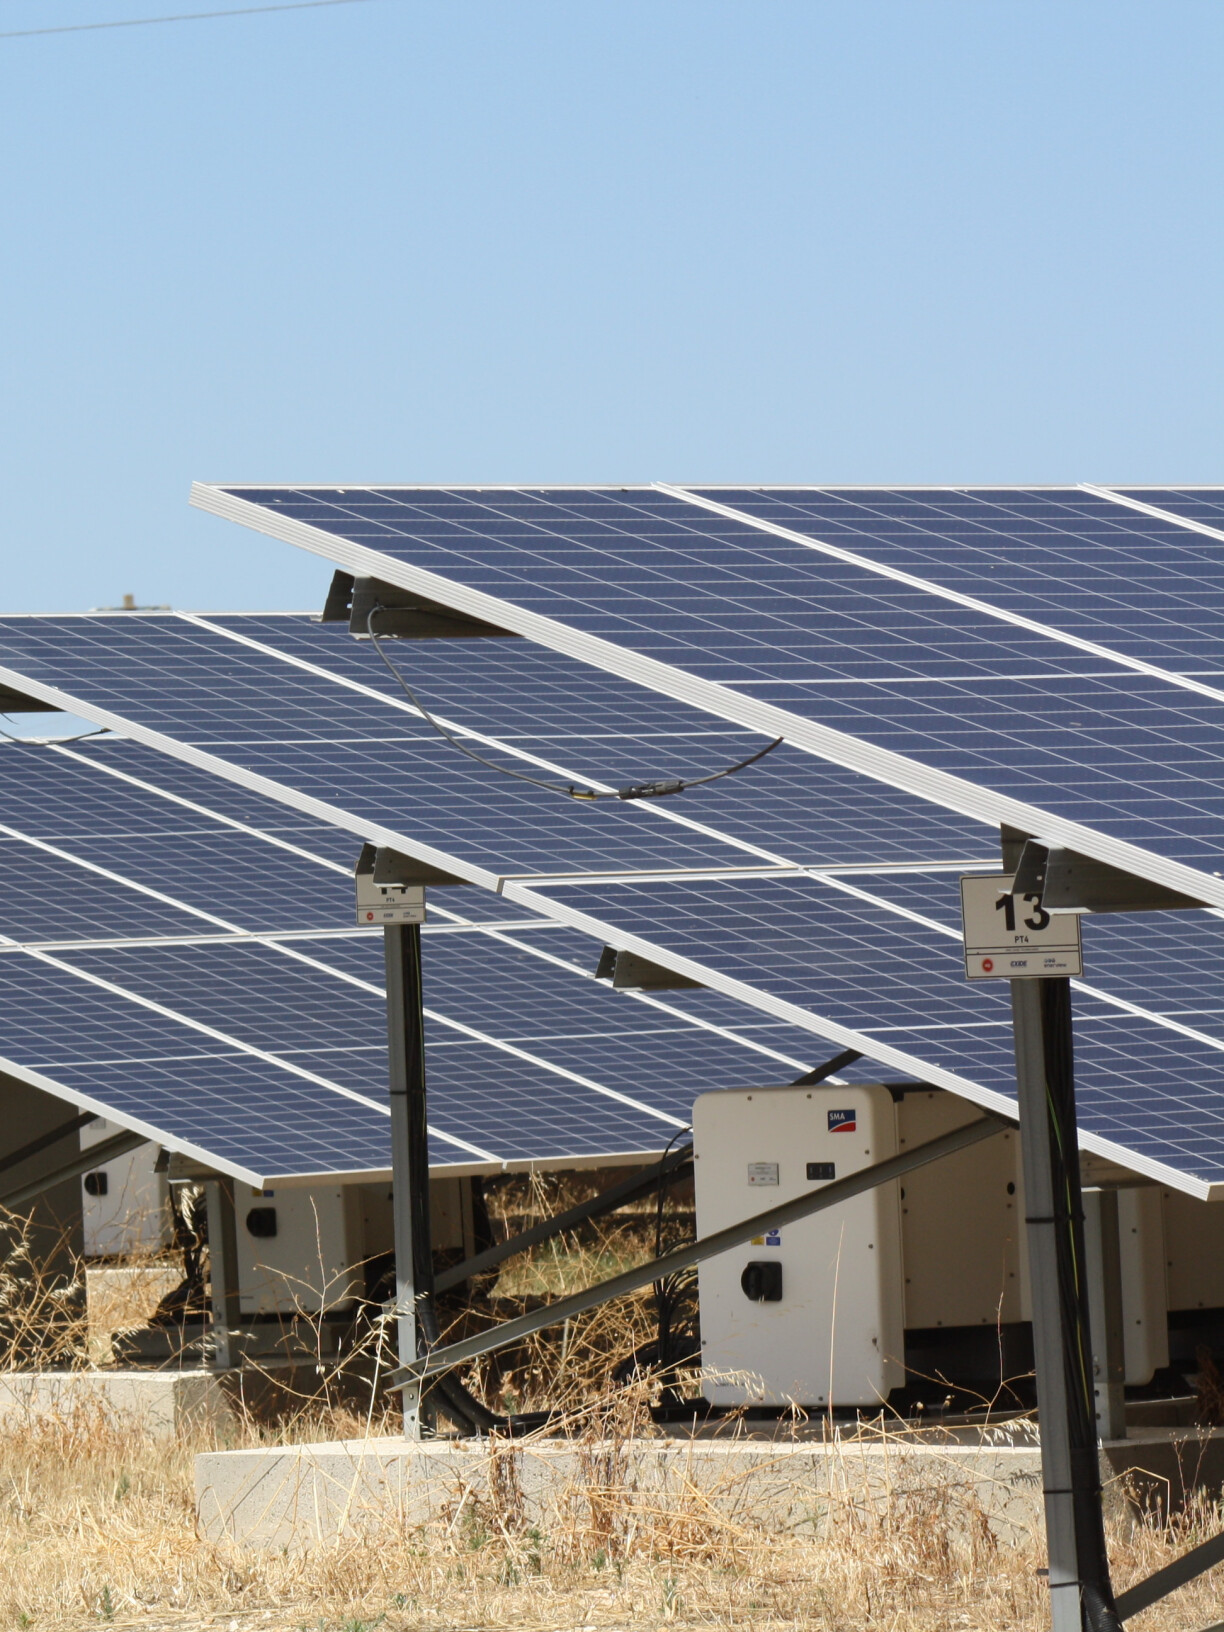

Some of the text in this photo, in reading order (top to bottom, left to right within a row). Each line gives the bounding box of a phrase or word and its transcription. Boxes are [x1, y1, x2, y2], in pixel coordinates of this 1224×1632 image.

[995, 893, 1050, 931] 13
[1014, 935, 1029, 944] PT4
[829, 1112, 846, 1121] SMA
